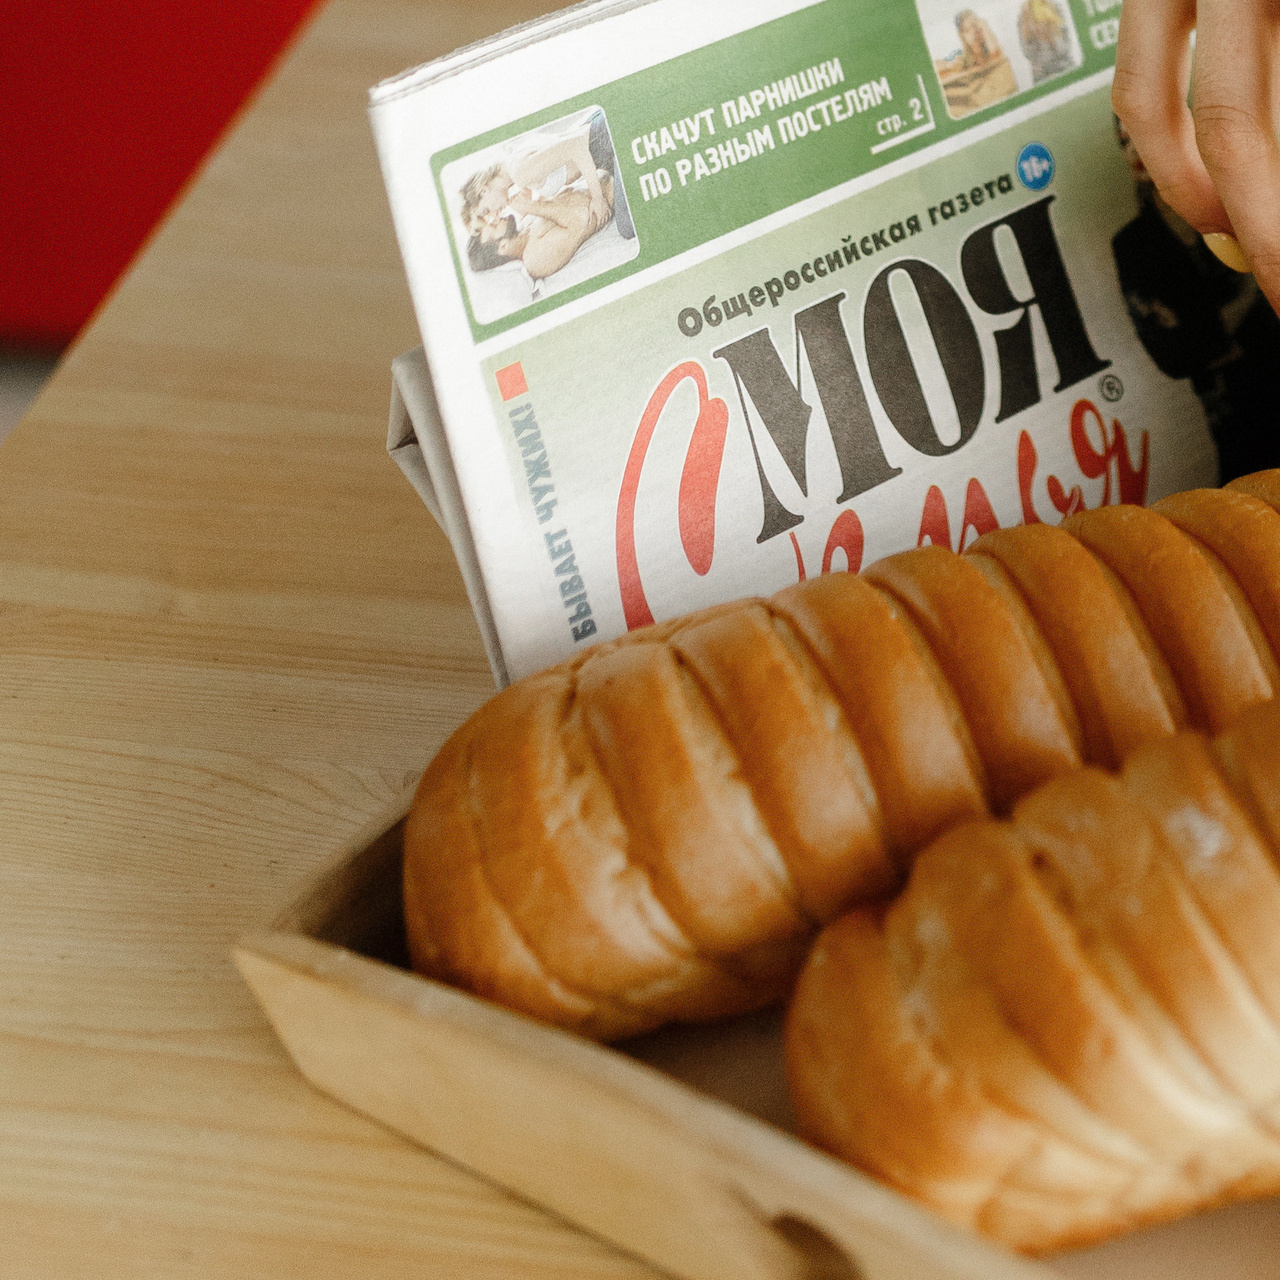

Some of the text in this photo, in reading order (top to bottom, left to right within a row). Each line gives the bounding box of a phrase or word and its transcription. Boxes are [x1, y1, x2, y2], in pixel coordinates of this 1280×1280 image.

[631, 57, 845, 165] СКАЧУТ ПАРНИШКИ
[638, 76, 893, 202] ПО РАЗНЫМ ПОСТЕЛЯМ
[876, 97, 924, 138] стр. 2
[677, 172, 1015, 338] Общероссийская газета
[712, 195, 1112, 544] МОЯ
[508, 402, 597, 642] БЫВАЕТ ЧУЖИХ!
